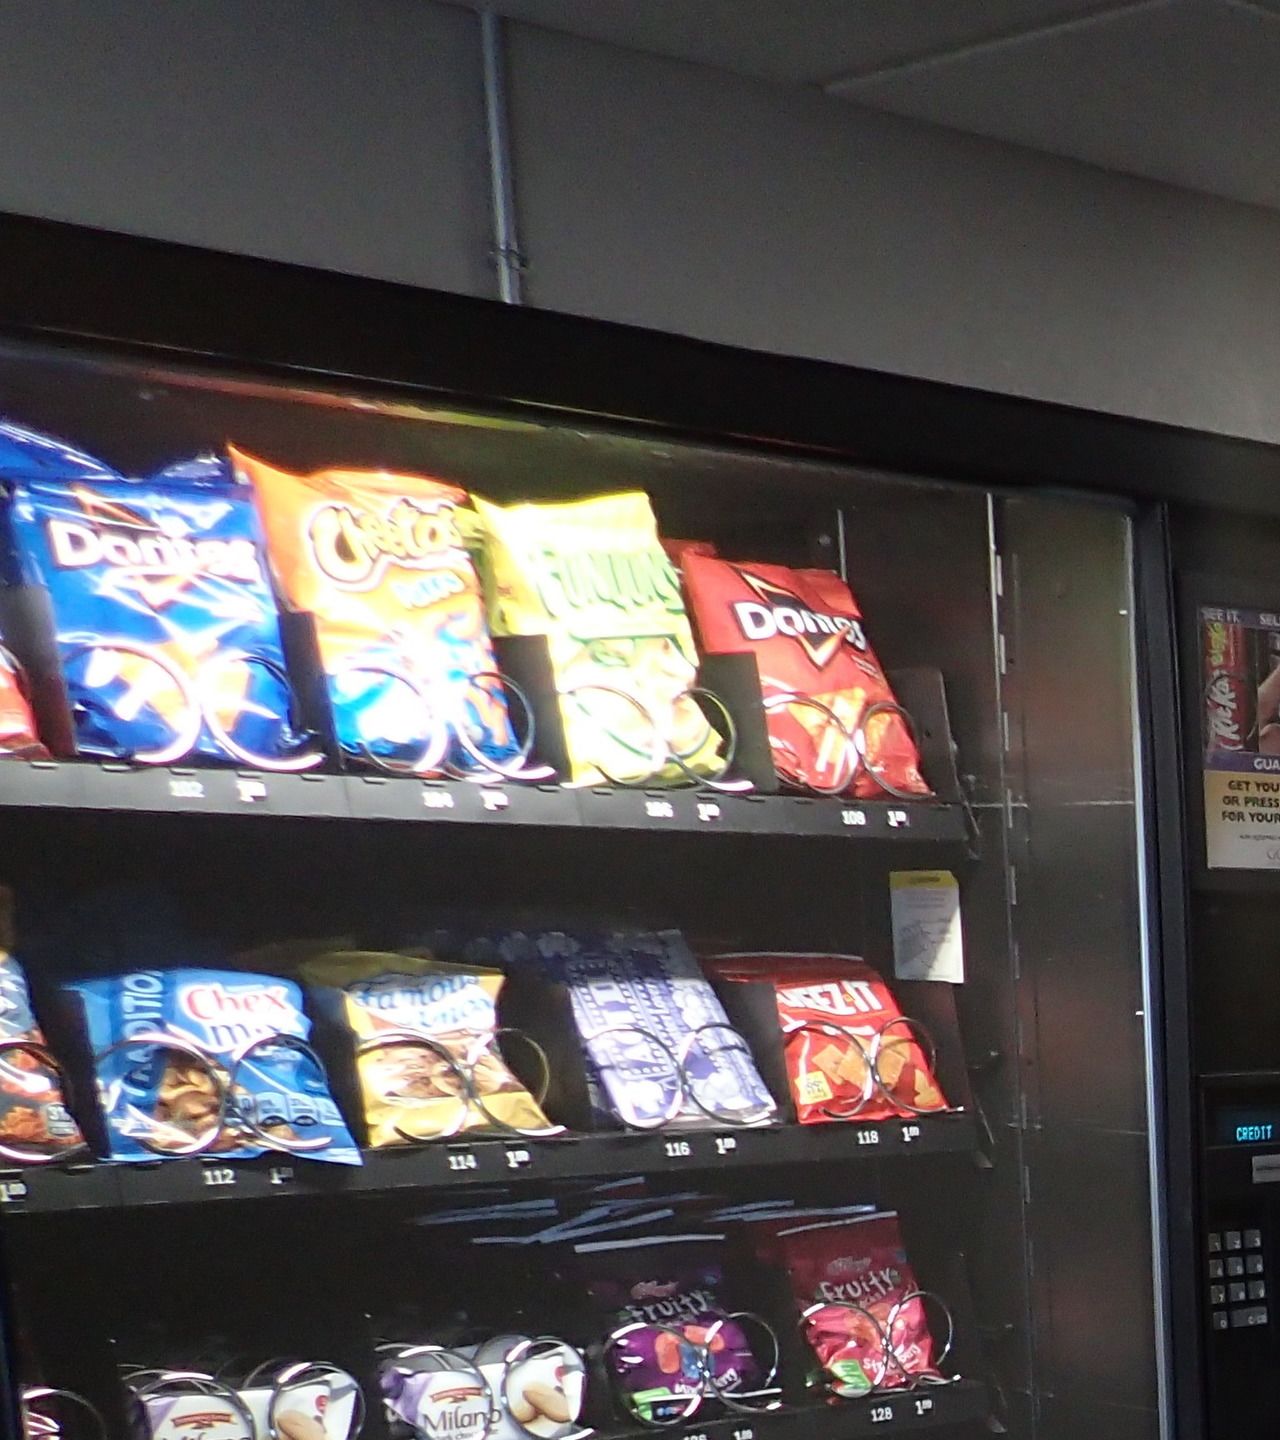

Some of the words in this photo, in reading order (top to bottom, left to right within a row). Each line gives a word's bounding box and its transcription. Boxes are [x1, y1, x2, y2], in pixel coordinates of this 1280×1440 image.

[308, 497, 464, 585] Cheetos
[45, 518, 258, 582] Doritos
[732, 600, 870, 654] Doritos
[1227, 779, 1252, 793] GET
[1222, 795, 1241, 808] OR
[1244, 797, 1280, 810] PRESS
[1221, 810, 1246, 823] FOR
[184, 985, 288, 1021] Chex
[857, 1130, 879, 1145] 118
[1235, 1124, 1273, 1141] CREDIT
[664, 1141, 691, 1157] 116
[447, 1154, 478, 1170] 114
[202, 1168, 237, 1185] 112
[870, 1406, 893, 1422] 128
